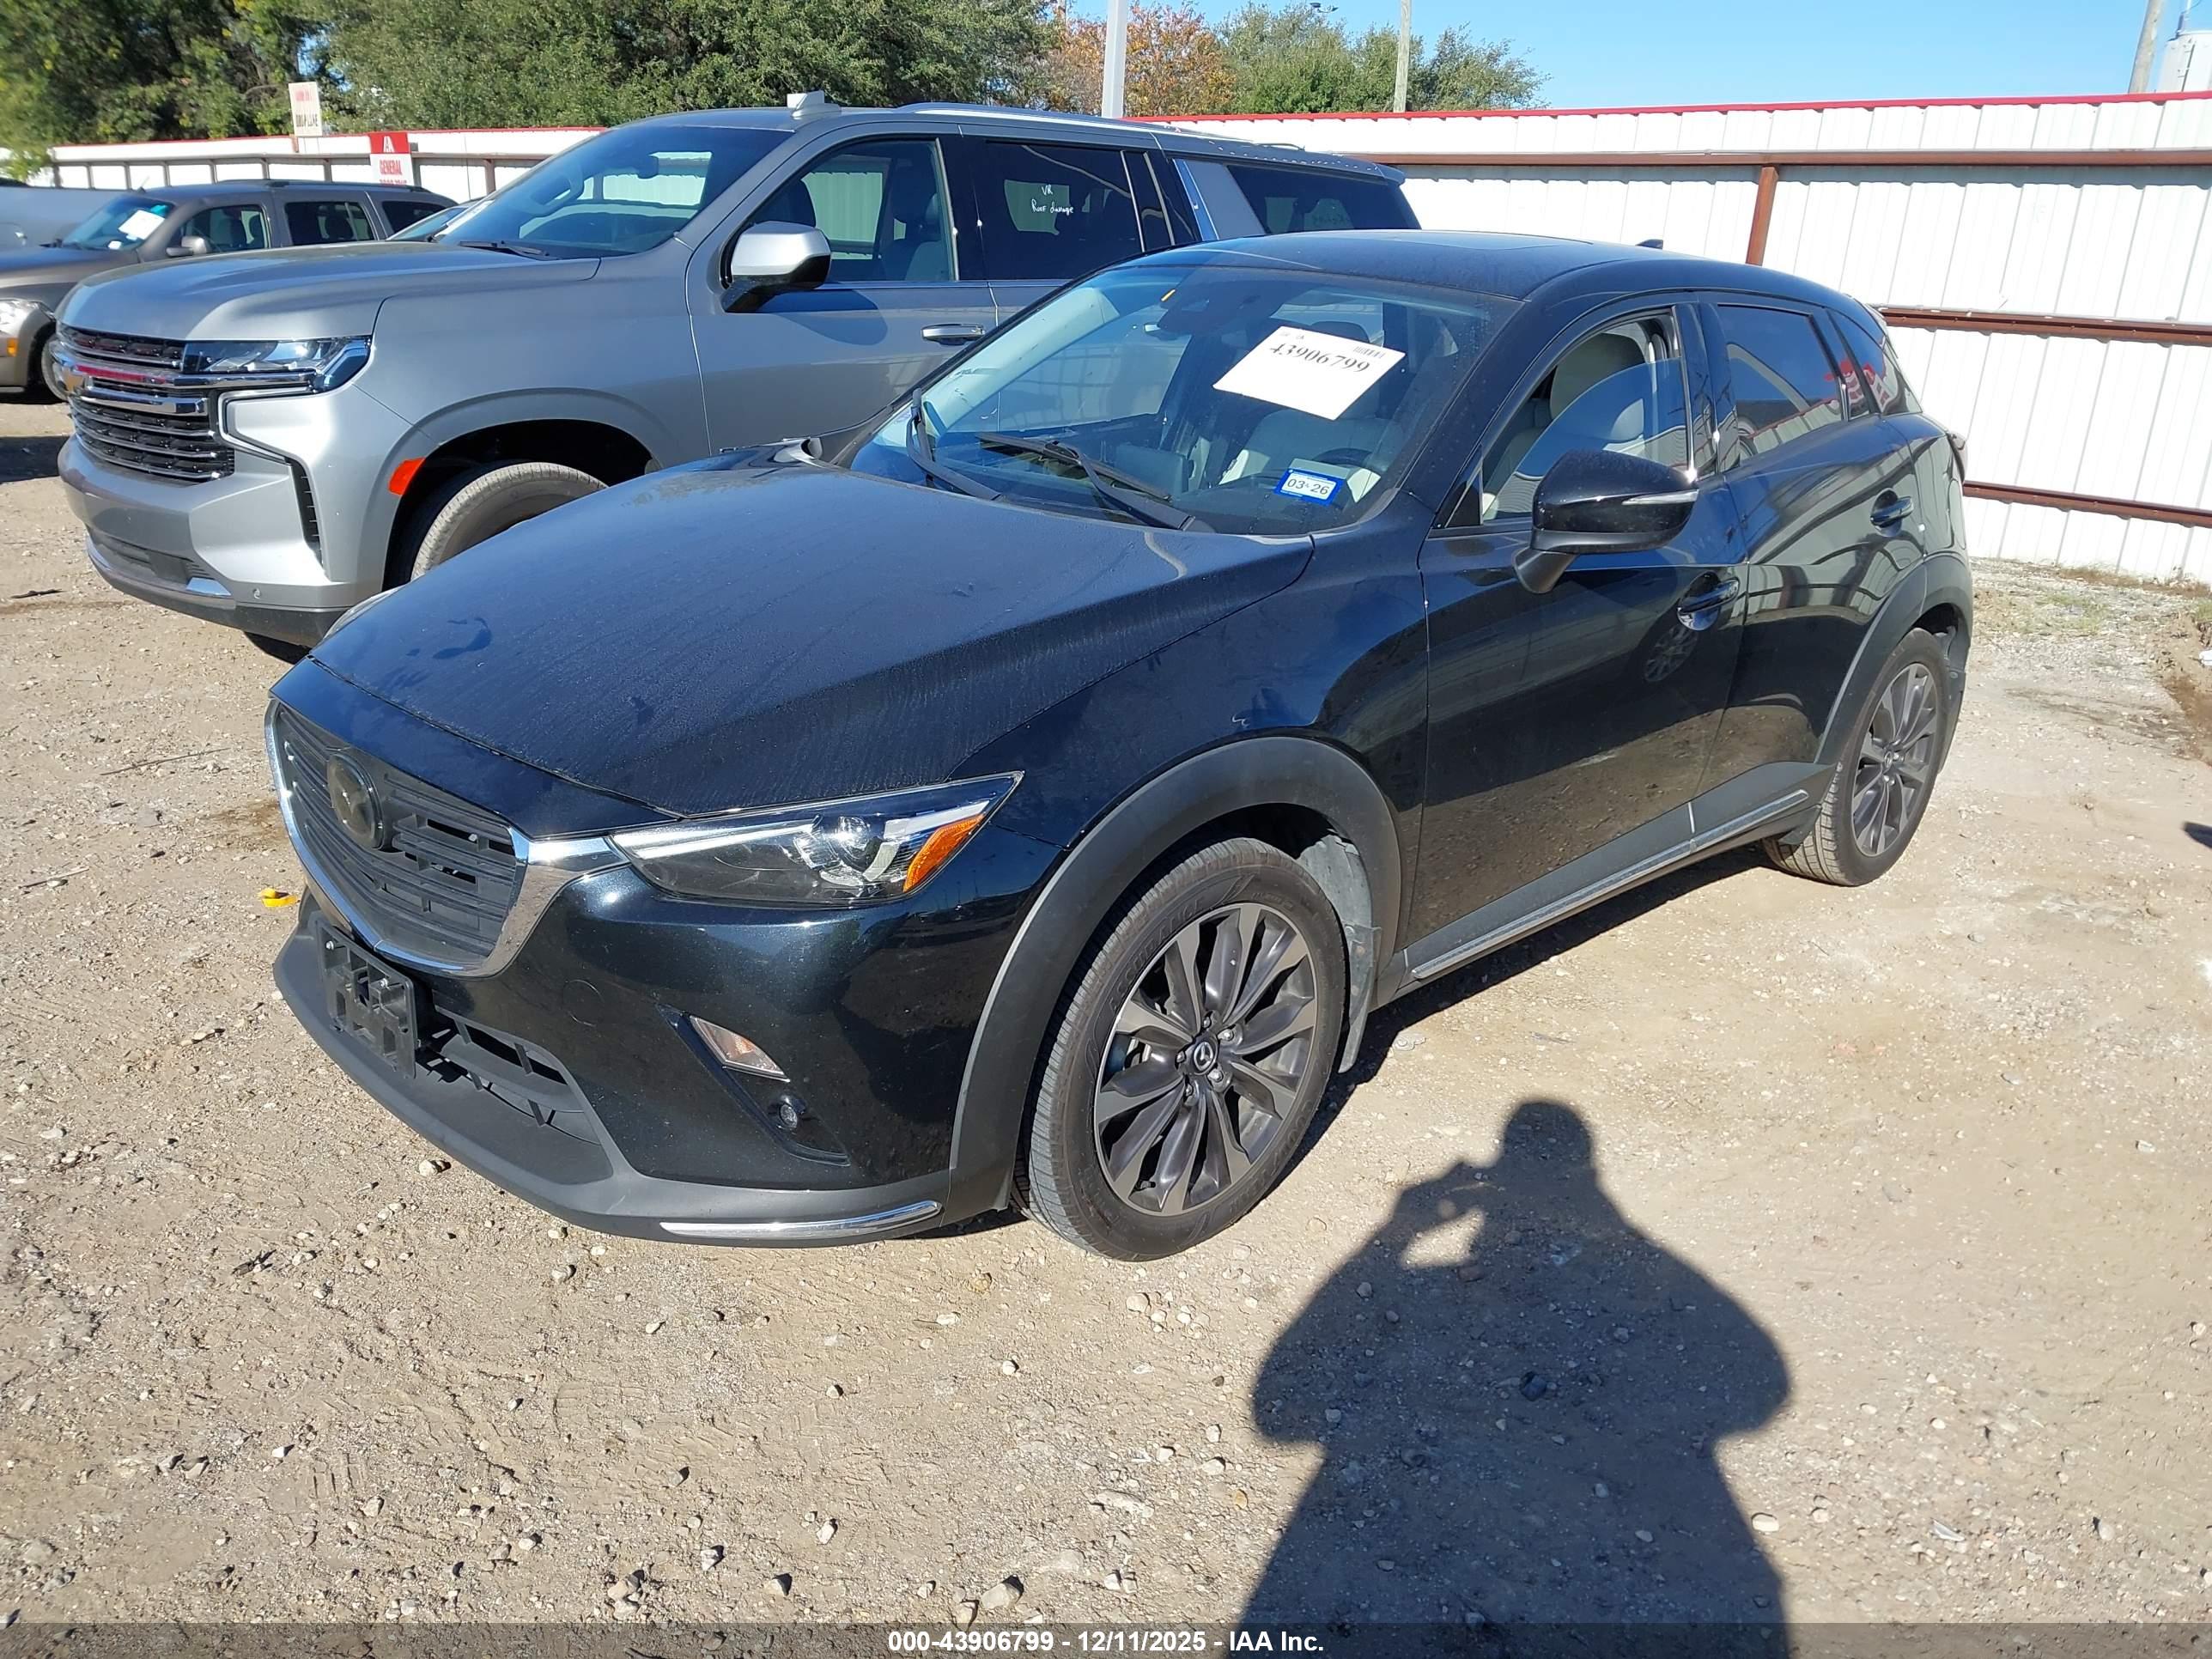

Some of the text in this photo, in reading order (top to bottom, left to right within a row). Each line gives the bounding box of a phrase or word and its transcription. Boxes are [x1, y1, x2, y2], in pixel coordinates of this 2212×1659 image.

[379, 159, 404, 175] GENERAL
[1042, 184, 1054, 196] VR
[1269, 343, 1370, 373] 43906799
